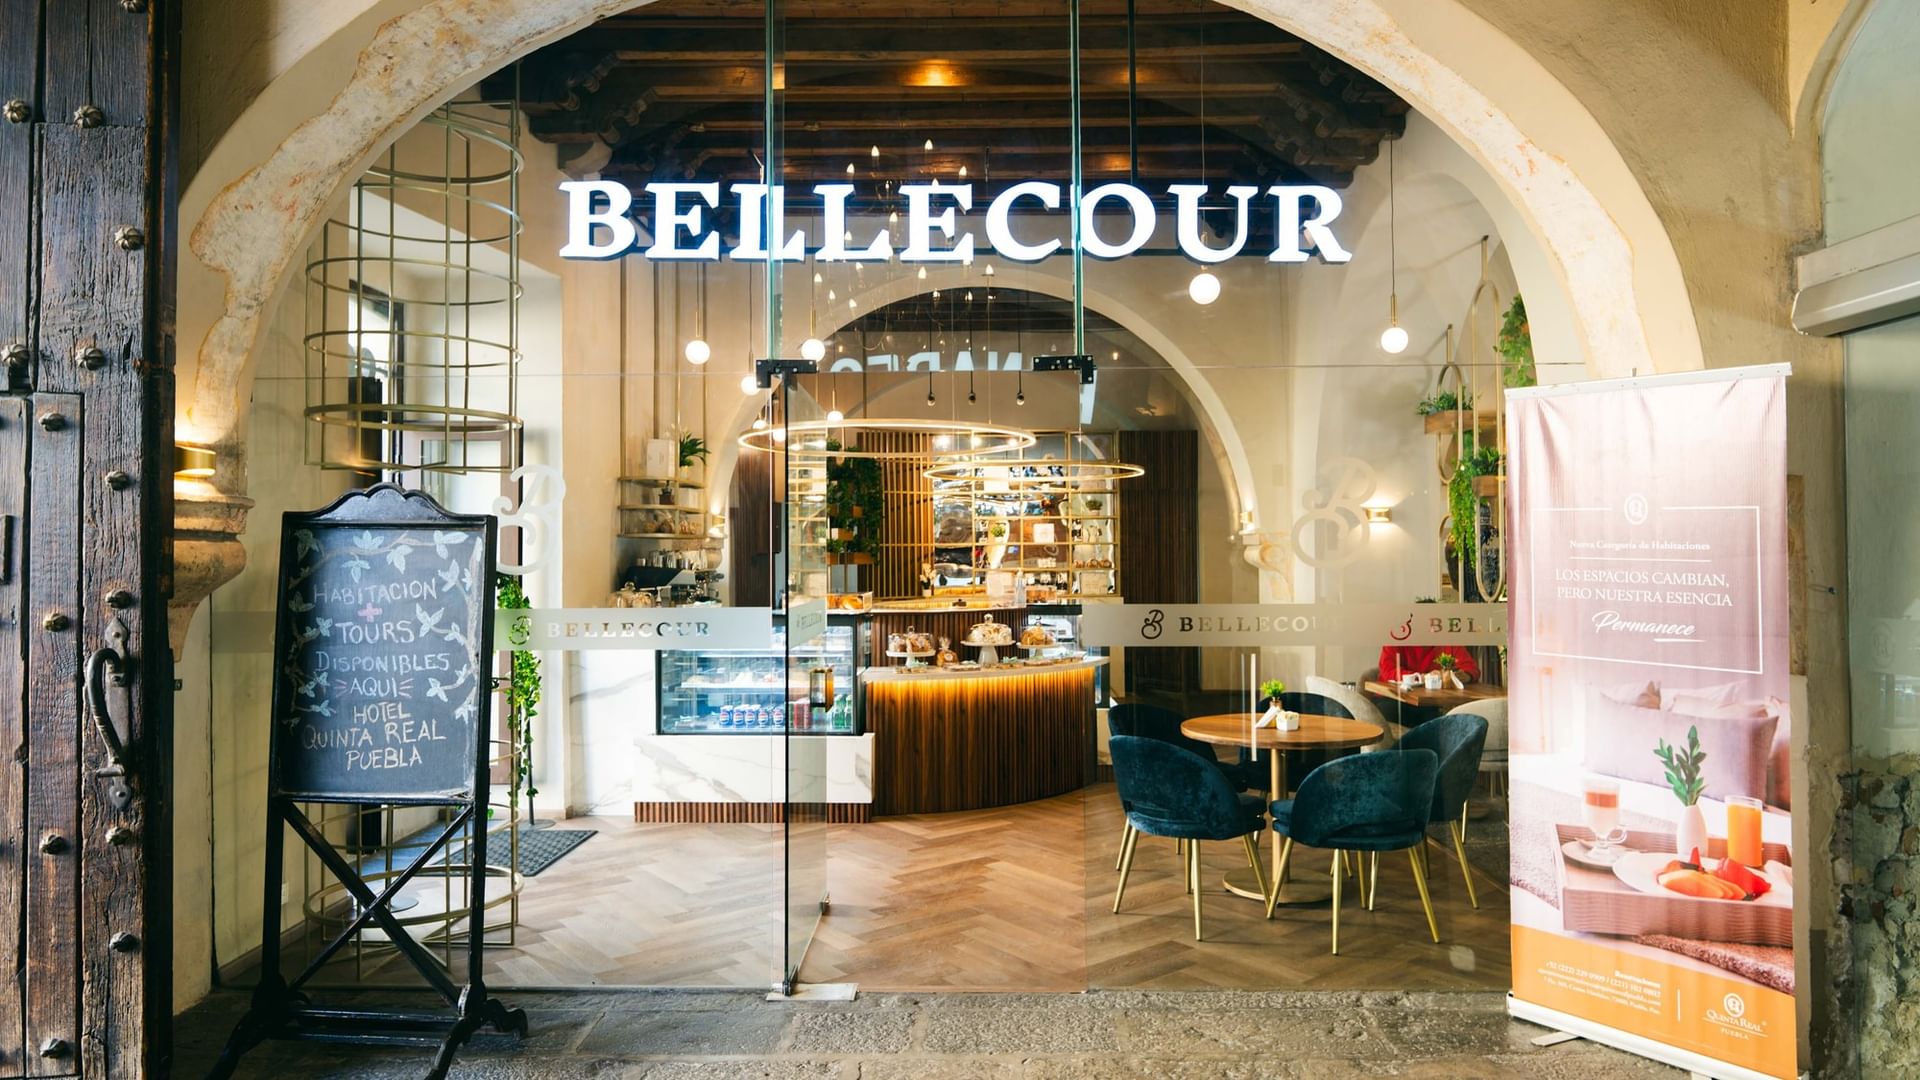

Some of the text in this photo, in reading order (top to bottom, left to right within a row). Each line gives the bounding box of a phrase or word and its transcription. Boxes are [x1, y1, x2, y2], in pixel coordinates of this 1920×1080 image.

[558, 181, 1354, 263] BELLECOUR
[1555, 568, 1729, 587] LOS ESPACIOS CAMBIAN,
[1557, 588, 1733, 607] PERO NUESTRA ESENCIA
[335, 620, 415, 644] TOURS
[548, 622, 711, 638] BELLECOUR
[1592, 610, 1696, 636] Permanece
[315, 651, 451, 675] DISPONIBLES
[349, 677, 397, 698] AQUI
[353, 702, 411, 725] HOTEL
[303, 718, 447, 750] QUINTA REAL
[346, 747, 423, 771] PUEBLA
